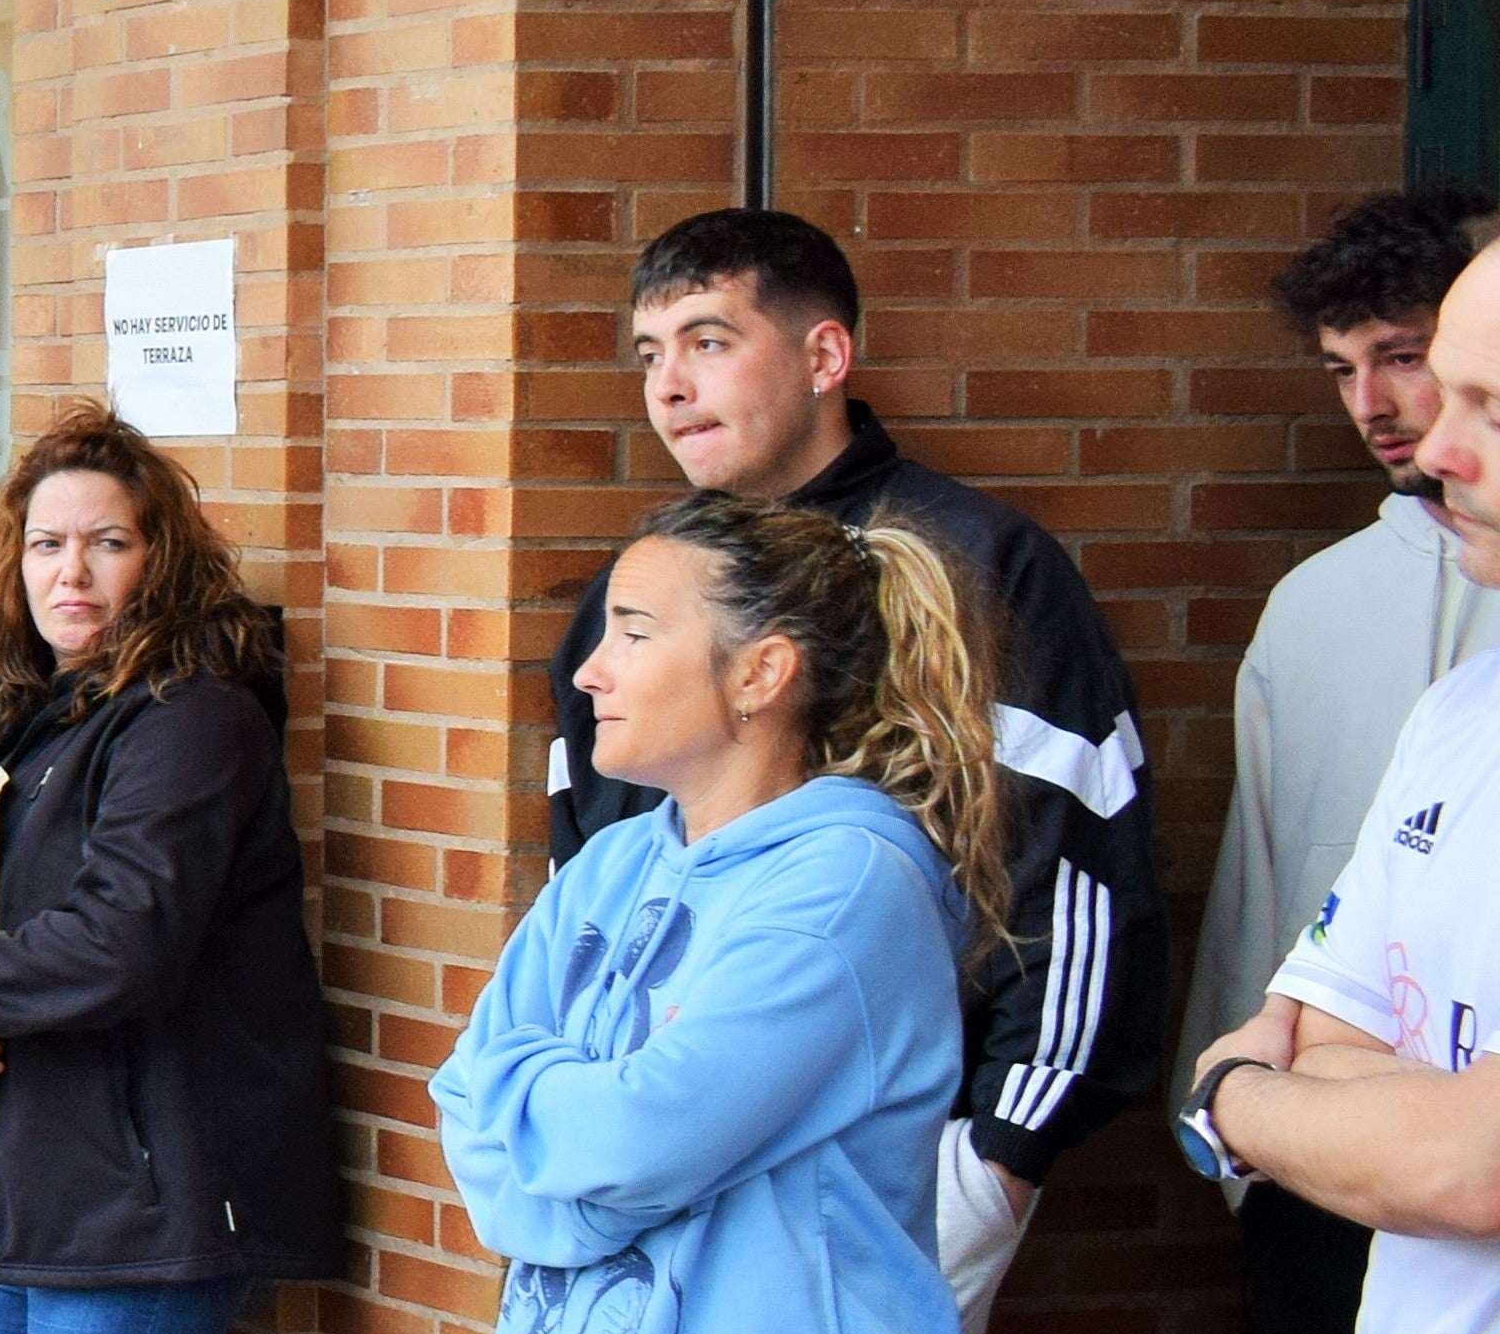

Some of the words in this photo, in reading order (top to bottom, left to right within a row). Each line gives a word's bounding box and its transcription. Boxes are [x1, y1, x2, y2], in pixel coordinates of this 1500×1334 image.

[113, 319, 128, 335] NO
[131, 317, 151, 334] HAY
[154, 315, 210, 333] SERVICIO
[213, 314, 228, 331] DE
[143, 346, 193, 364] TERRAZA
